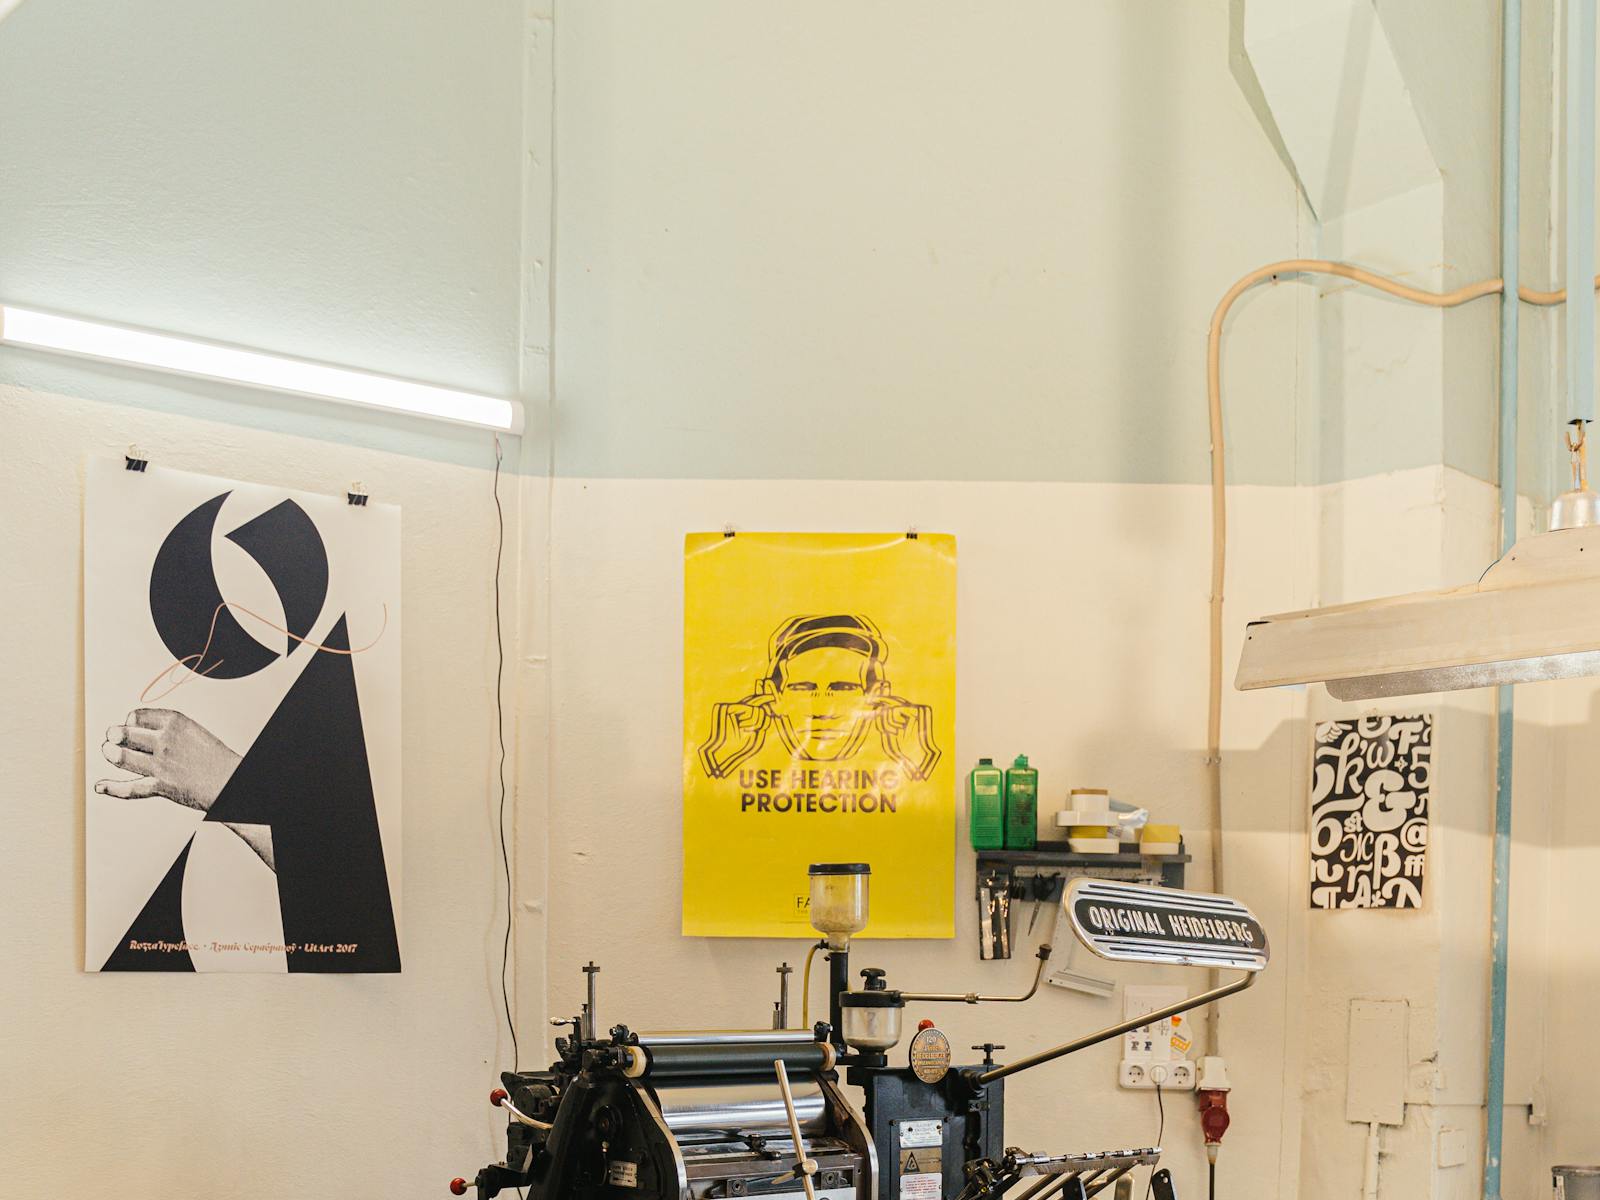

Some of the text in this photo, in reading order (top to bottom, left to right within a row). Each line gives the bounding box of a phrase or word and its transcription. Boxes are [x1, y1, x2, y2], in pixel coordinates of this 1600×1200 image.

[739, 769, 898, 790] USE HEARING
[741, 793, 897, 813] PROTECTION
[1089, 905, 1254, 943] ORIGINAL HEIDELBERG
[336, 943, 358, 953] 2017
